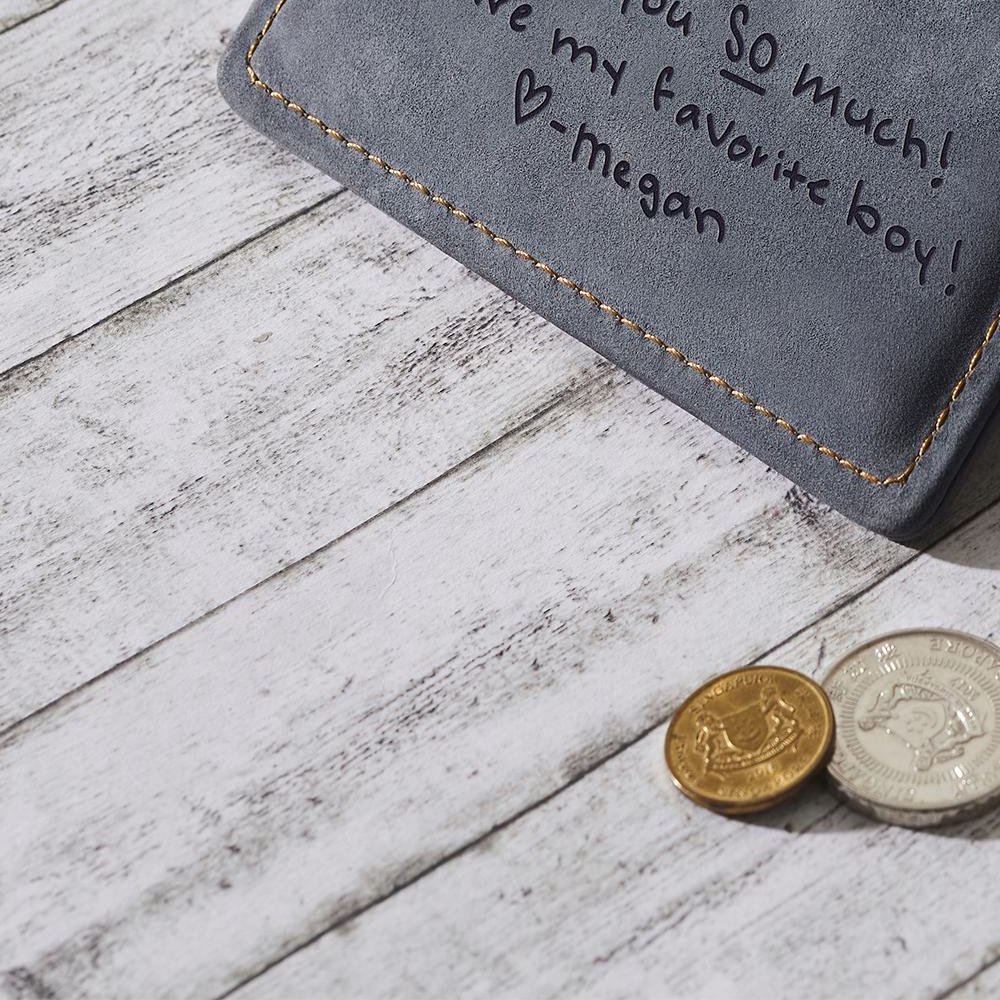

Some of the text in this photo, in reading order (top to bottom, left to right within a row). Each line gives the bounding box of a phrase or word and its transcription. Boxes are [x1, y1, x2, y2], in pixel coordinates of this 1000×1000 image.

[551, 27, 628, 97] my
[653, 66, 831, 206] favorite
[847, 179, 963, 297] boy!
[722, 3, 779, 80] SO
[793, 63, 954, 189] much!
